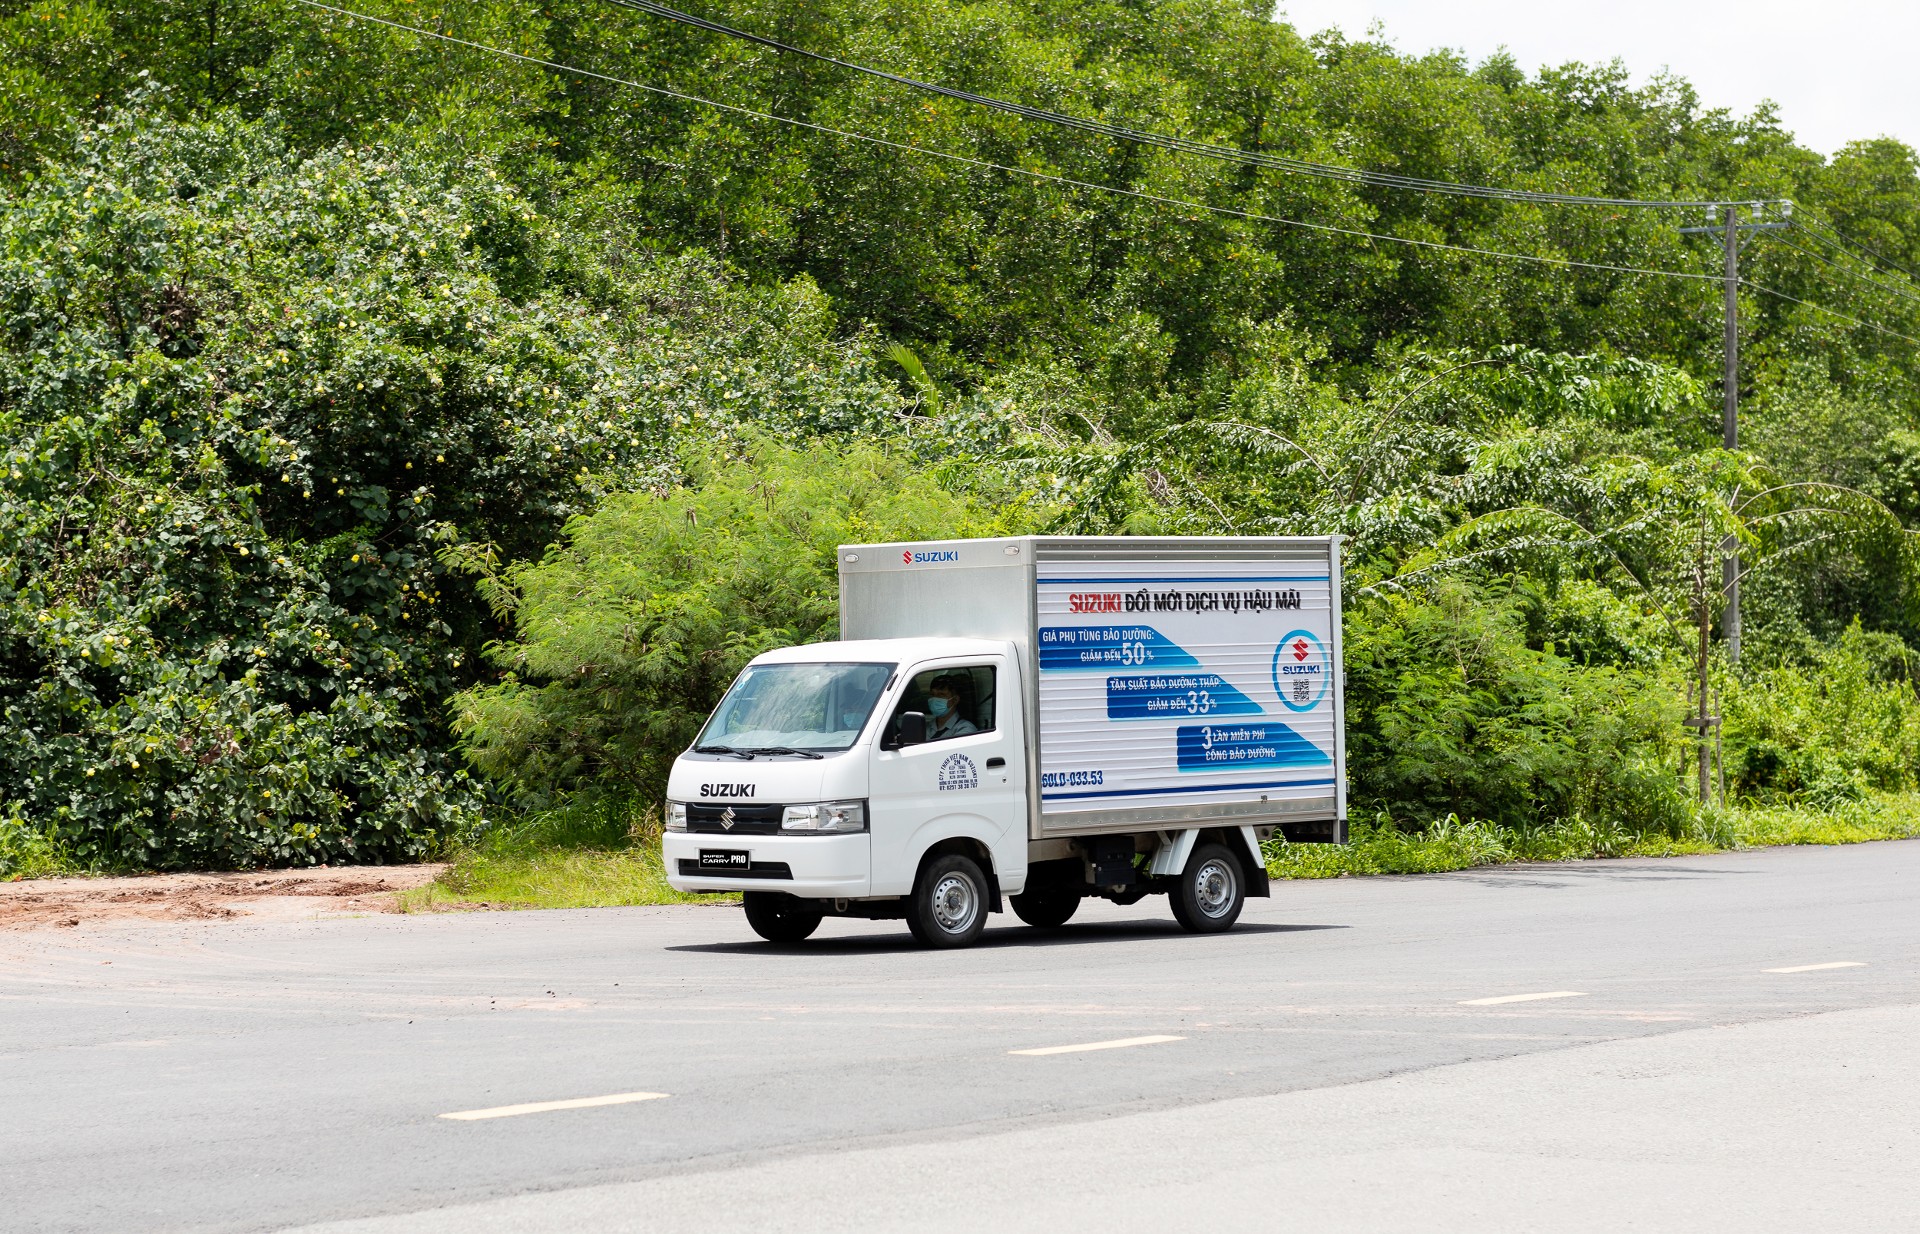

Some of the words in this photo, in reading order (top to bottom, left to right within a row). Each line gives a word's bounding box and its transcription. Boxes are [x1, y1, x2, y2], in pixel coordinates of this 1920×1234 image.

[914, 551, 958, 562] SUZUKI
[1069, 593, 1121, 613] SUZUKI
[1125, 588, 1150, 612] ĐỔI
[1154, 589, 1182, 612] MỚI
[1186, 592, 1218, 614] DỊCH
[1221, 592, 1240, 614] VỤ
[1244, 589, 1271, 613] HẬU
[1275, 588, 1301, 610] MÃI
[1043, 630, 1057, 642] GIÁ
[1060, 631, 1075, 643] PHỤ
[1078, 628, 1100, 641] TÙNG
[1103, 627, 1120, 640] BẢO
[1122, 627, 1154, 640] DƯỠNG:
[1282, 665, 1320, 674] SUZUKI
[1201, 726, 1212, 750] 3
[1205, 749, 1228, 761] CÔNG
[1229, 747, 1246, 759] BẢO
[1042, 770, 1104, 788] 60LD-033.53
[700, 784, 755, 797] SUZUKI
[730, 854, 746, 864] PRO
